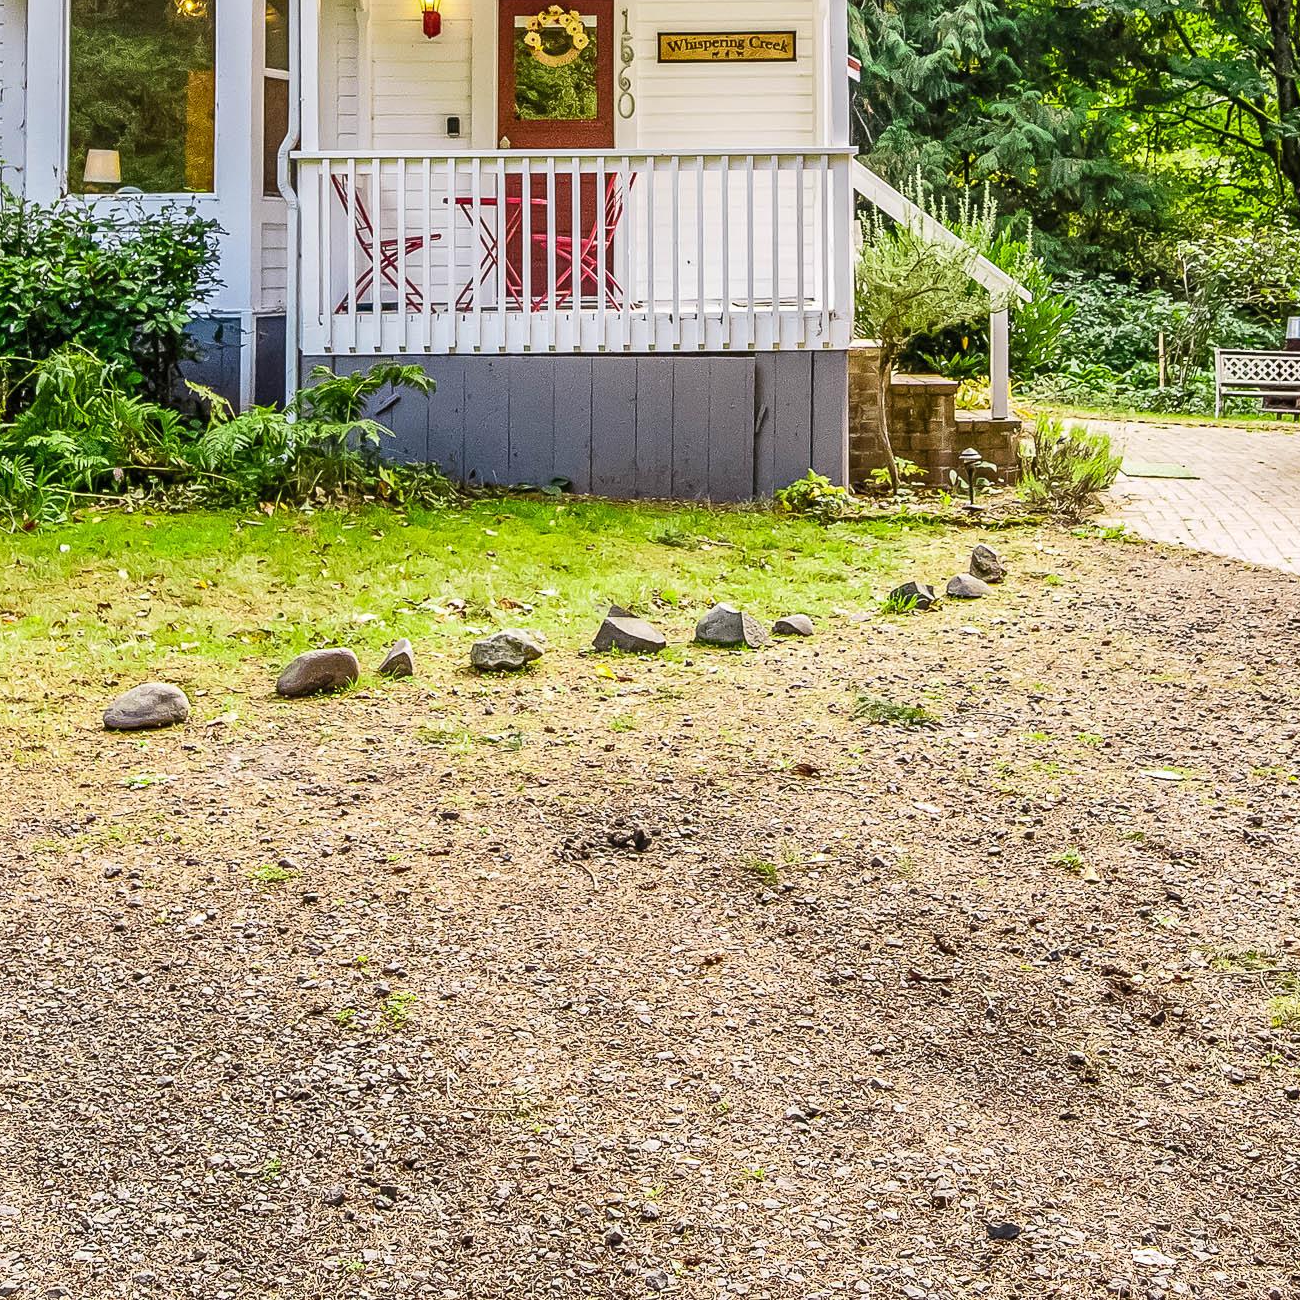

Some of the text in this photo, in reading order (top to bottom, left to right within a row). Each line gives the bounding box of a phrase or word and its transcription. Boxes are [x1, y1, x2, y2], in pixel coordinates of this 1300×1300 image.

[618, 8, 635, 119] 1560
[667, 36, 789, 53] Whispering Creek
